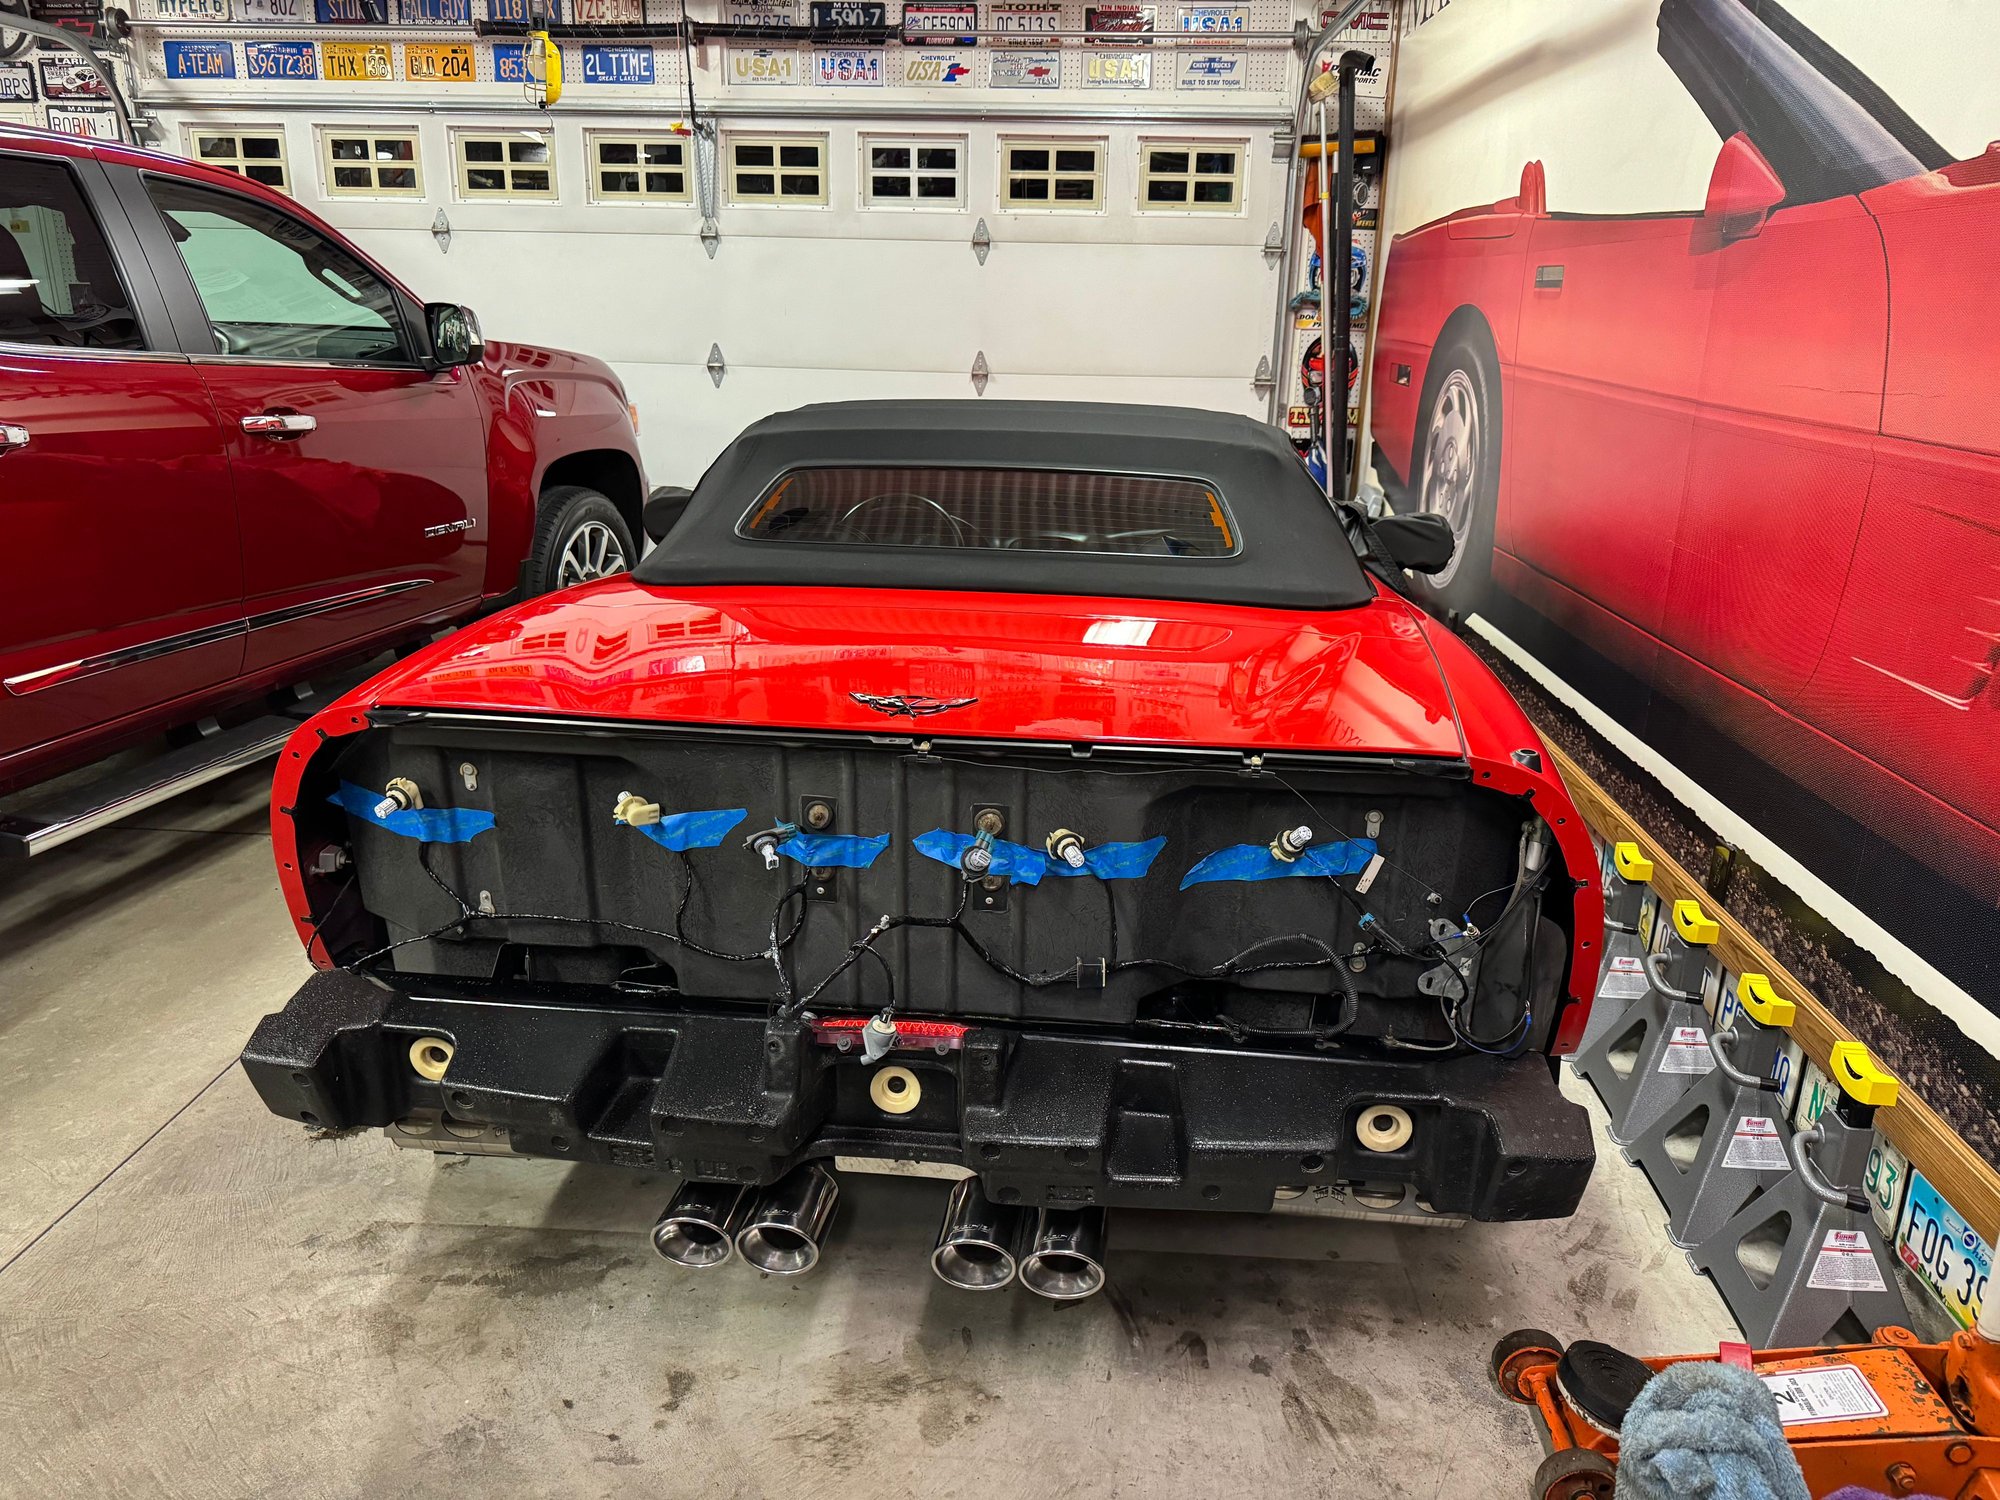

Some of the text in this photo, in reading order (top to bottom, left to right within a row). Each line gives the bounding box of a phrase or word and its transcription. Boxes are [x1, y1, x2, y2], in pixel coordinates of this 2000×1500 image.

[402, 0, 466, 19] FALL GUY
[178, 53, 224, 74] A-TEAM
[585, 54, 650, 76] 2L TIME
[830, 51, 867, 59] CHEVROLET
[327, 56, 388, 77] THX 138
[441, 56, 470, 77] 204
[52, 116, 98, 137] ROBIN
[424, 517, 477, 539] DENALI
[1906, 1199, 1954, 1281] FOG
